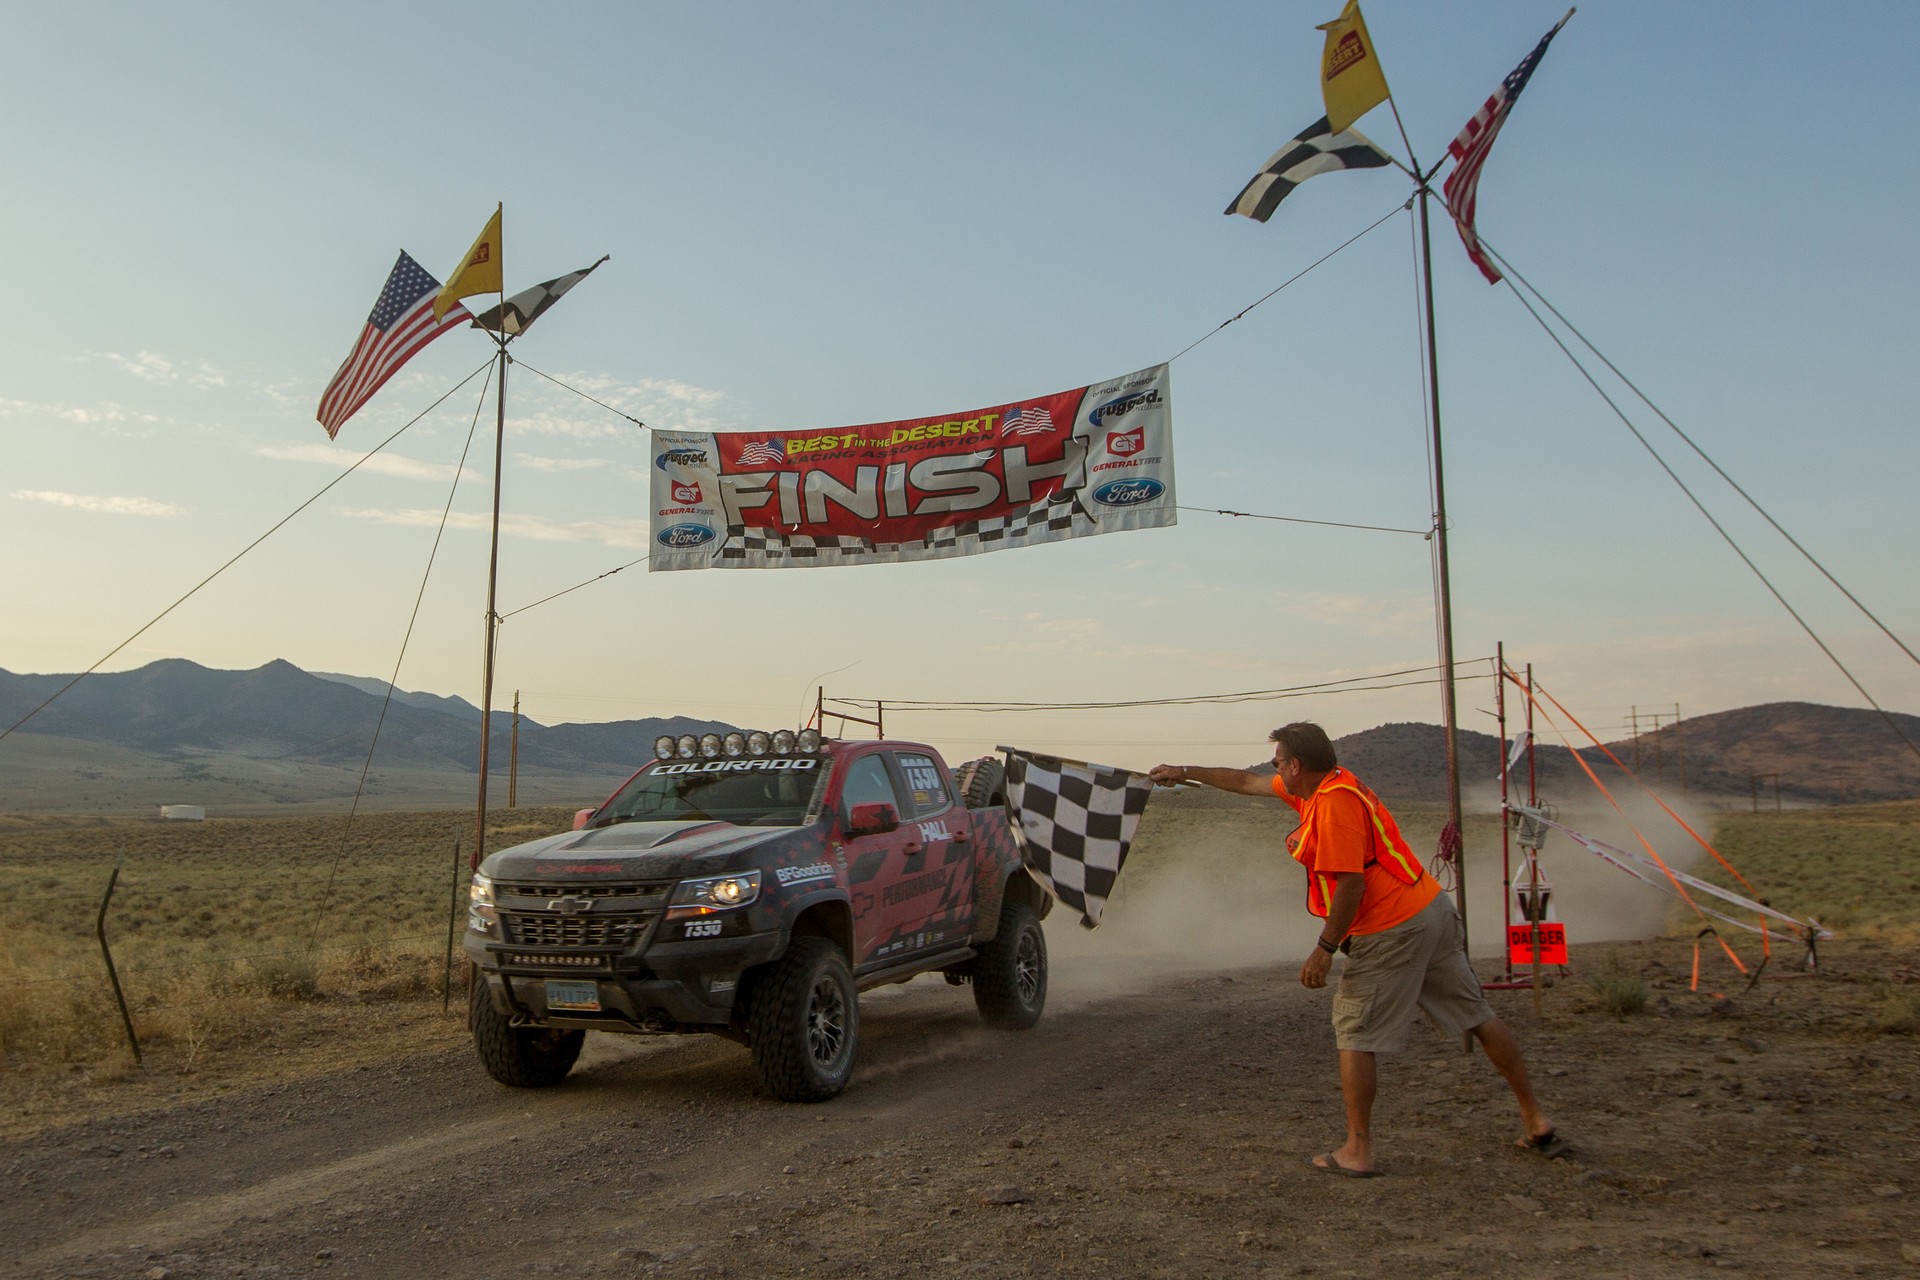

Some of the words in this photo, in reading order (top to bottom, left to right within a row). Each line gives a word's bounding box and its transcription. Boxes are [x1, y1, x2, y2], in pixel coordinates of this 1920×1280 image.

[787, 434, 858, 455] BEST
[855, 439, 866, 447] IN
[871, 438, 890, 448] THE
[890, 414, 999, 445] DESERT
[786, 450, 857, 466] RACING
[860, 432, 996, 460] ASSOCIATION
[716, 434, 1090, 526] FINISH
[1107, 481, 1150, 503] Ford
[669, 527, 704, 544] Ford
[649, 758, 817, 776] COLORADO
[917, 820, 953, 843] HALL
[776, 861, 835, 883] BFGoodrich
[1511, 929, 1565, 945] DAGER
